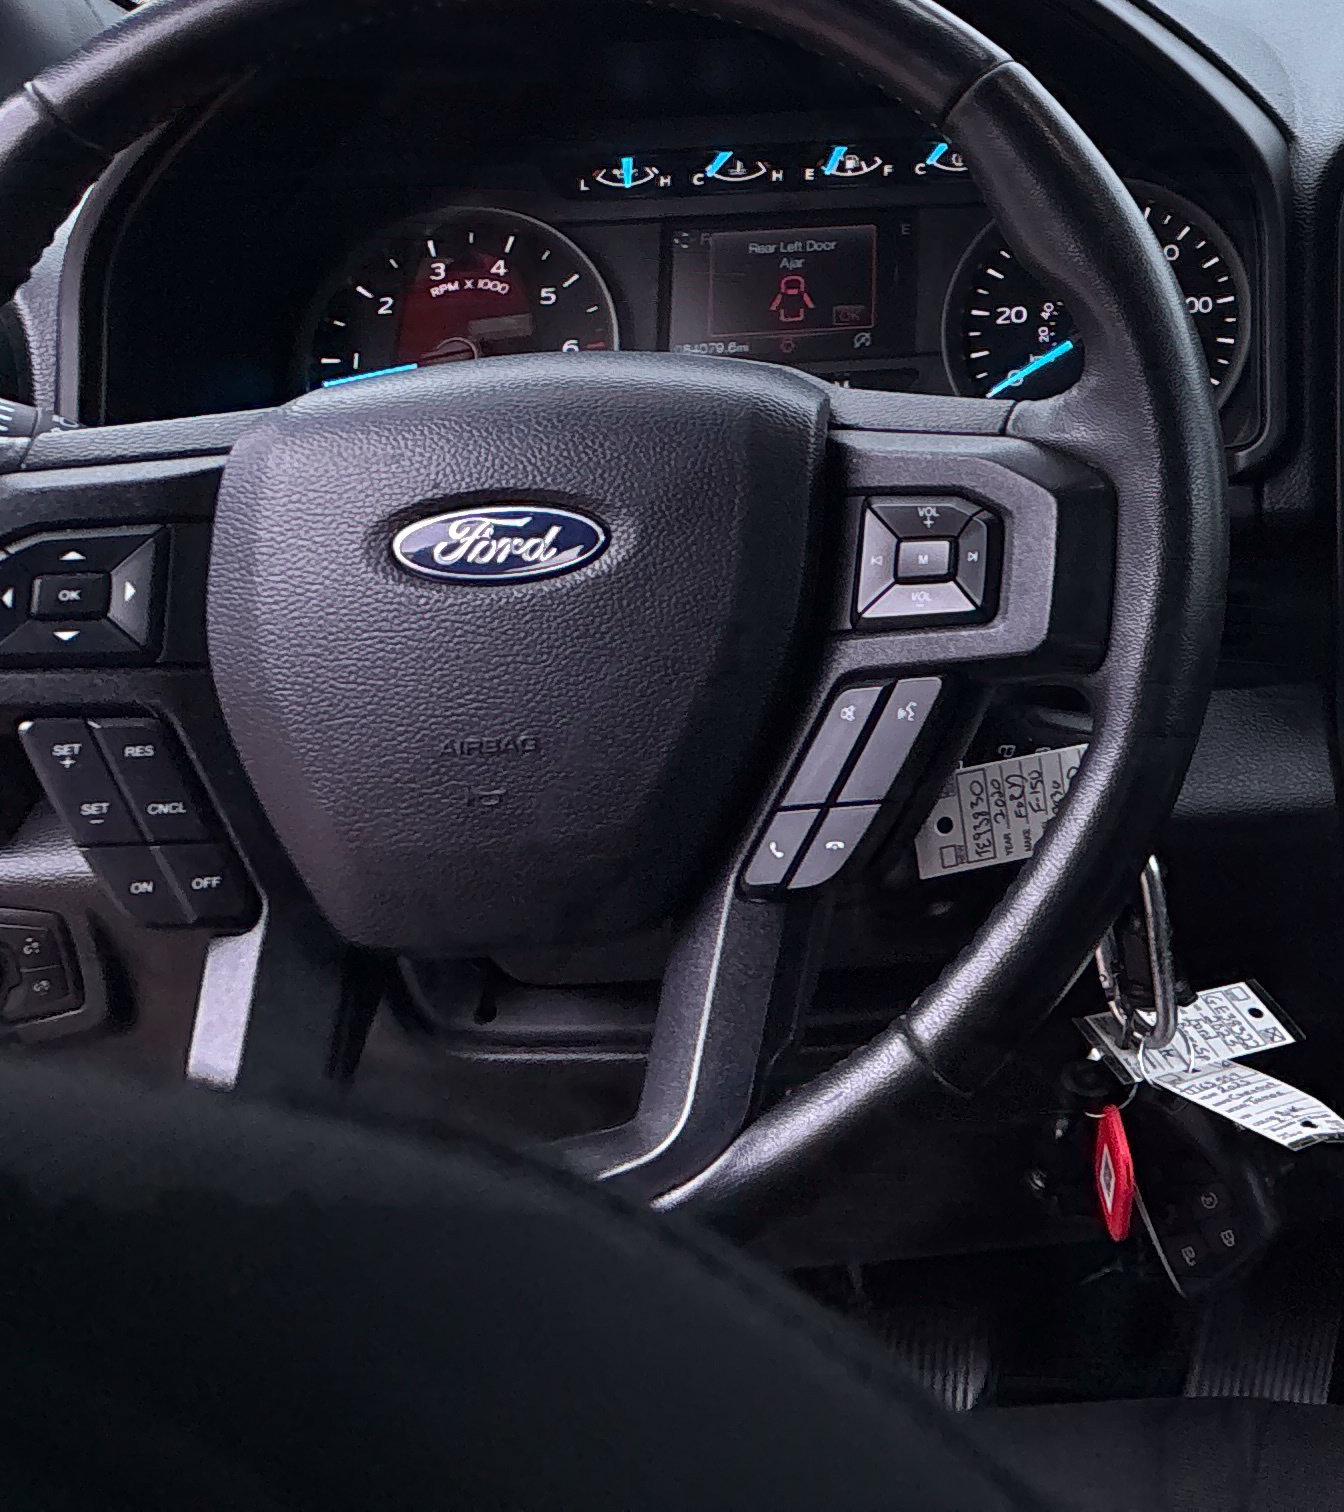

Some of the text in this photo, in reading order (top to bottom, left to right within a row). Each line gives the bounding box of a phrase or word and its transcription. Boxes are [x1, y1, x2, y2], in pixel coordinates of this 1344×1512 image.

[772, 170, 783, 181] H
[804, 169, 815, 180] E
[883, 165, 894, 176] F
[915, 163, 926, 175] C
[580, 179, 590, 191] L
[659, 176, 671, 187] H
[693, 174, 704, 185] C
[748, 239, 837, 255] Rear Left Door
[490, 259, 507, 276] 4
[779, 257, 805, 271] Ajar
[430, 262, 446, 280] 3
[430, 279, 459, 298] RPM
[477, 278, 510, 295] 1000
[540, 288, 556, 305] 5
[377, 297, 394, 315] 2
[995, 306, 1028, 325] 20
[1038, 326, 1050, 343] 20
[917, 507, 940, 517] VOL
[433, 516, 564, 566] Ford
[918, 554, 929, 565] M
[58, 589, 81, 602] OK
[911, 591, 933, 601] VOL
[52, 744, 82, 756] SET
[124, 745, 154, 758] RES
[438, 737, 538, 757] AIRBAG
[80, 803, 110, 816] SET
[147, 803, 186, 815] CNCL
[1003, 831, 1015, 856] YEAR
[130, 881, 154, 894] ON
[191, 876, 222, 889] OFF
